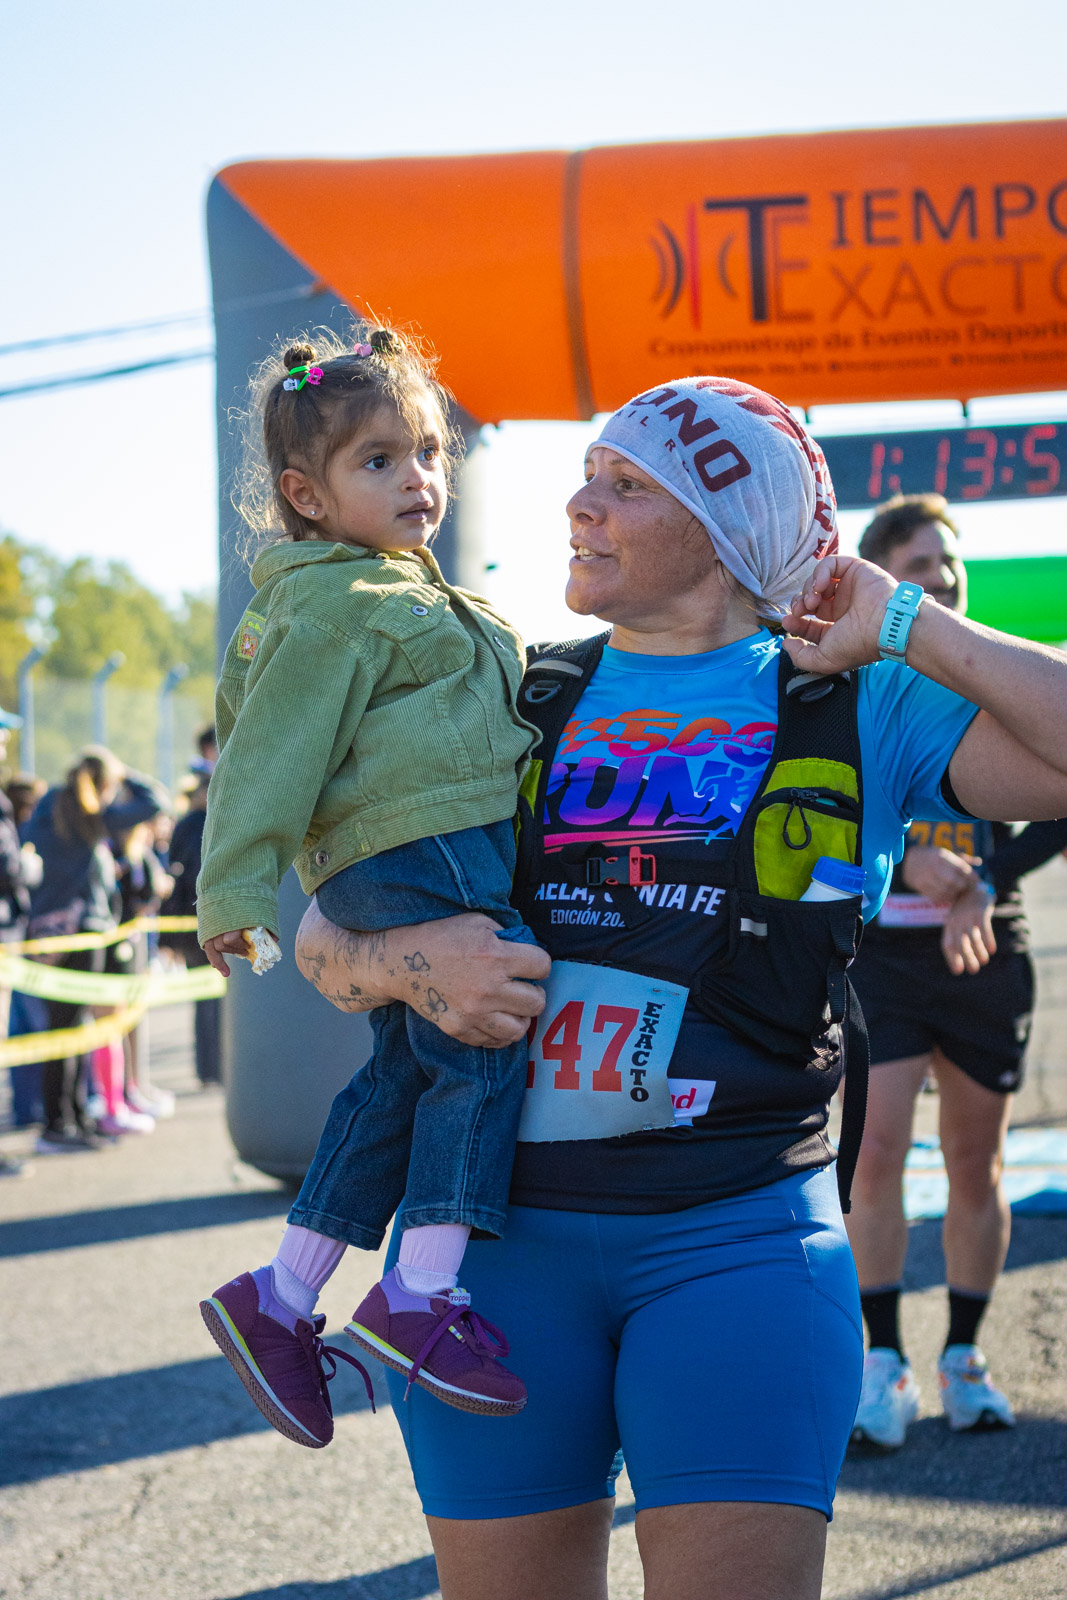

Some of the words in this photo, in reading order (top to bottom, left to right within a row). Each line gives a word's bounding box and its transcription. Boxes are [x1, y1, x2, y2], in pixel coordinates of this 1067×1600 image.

[824, 330, 854, 348] de
[861, 326, 961, 347] Eventos
[690, 885, 727, 916] FE
[551, 907, 601, 926] EDICIÓN
[629, 1001, 666, 1103] EXACTO
